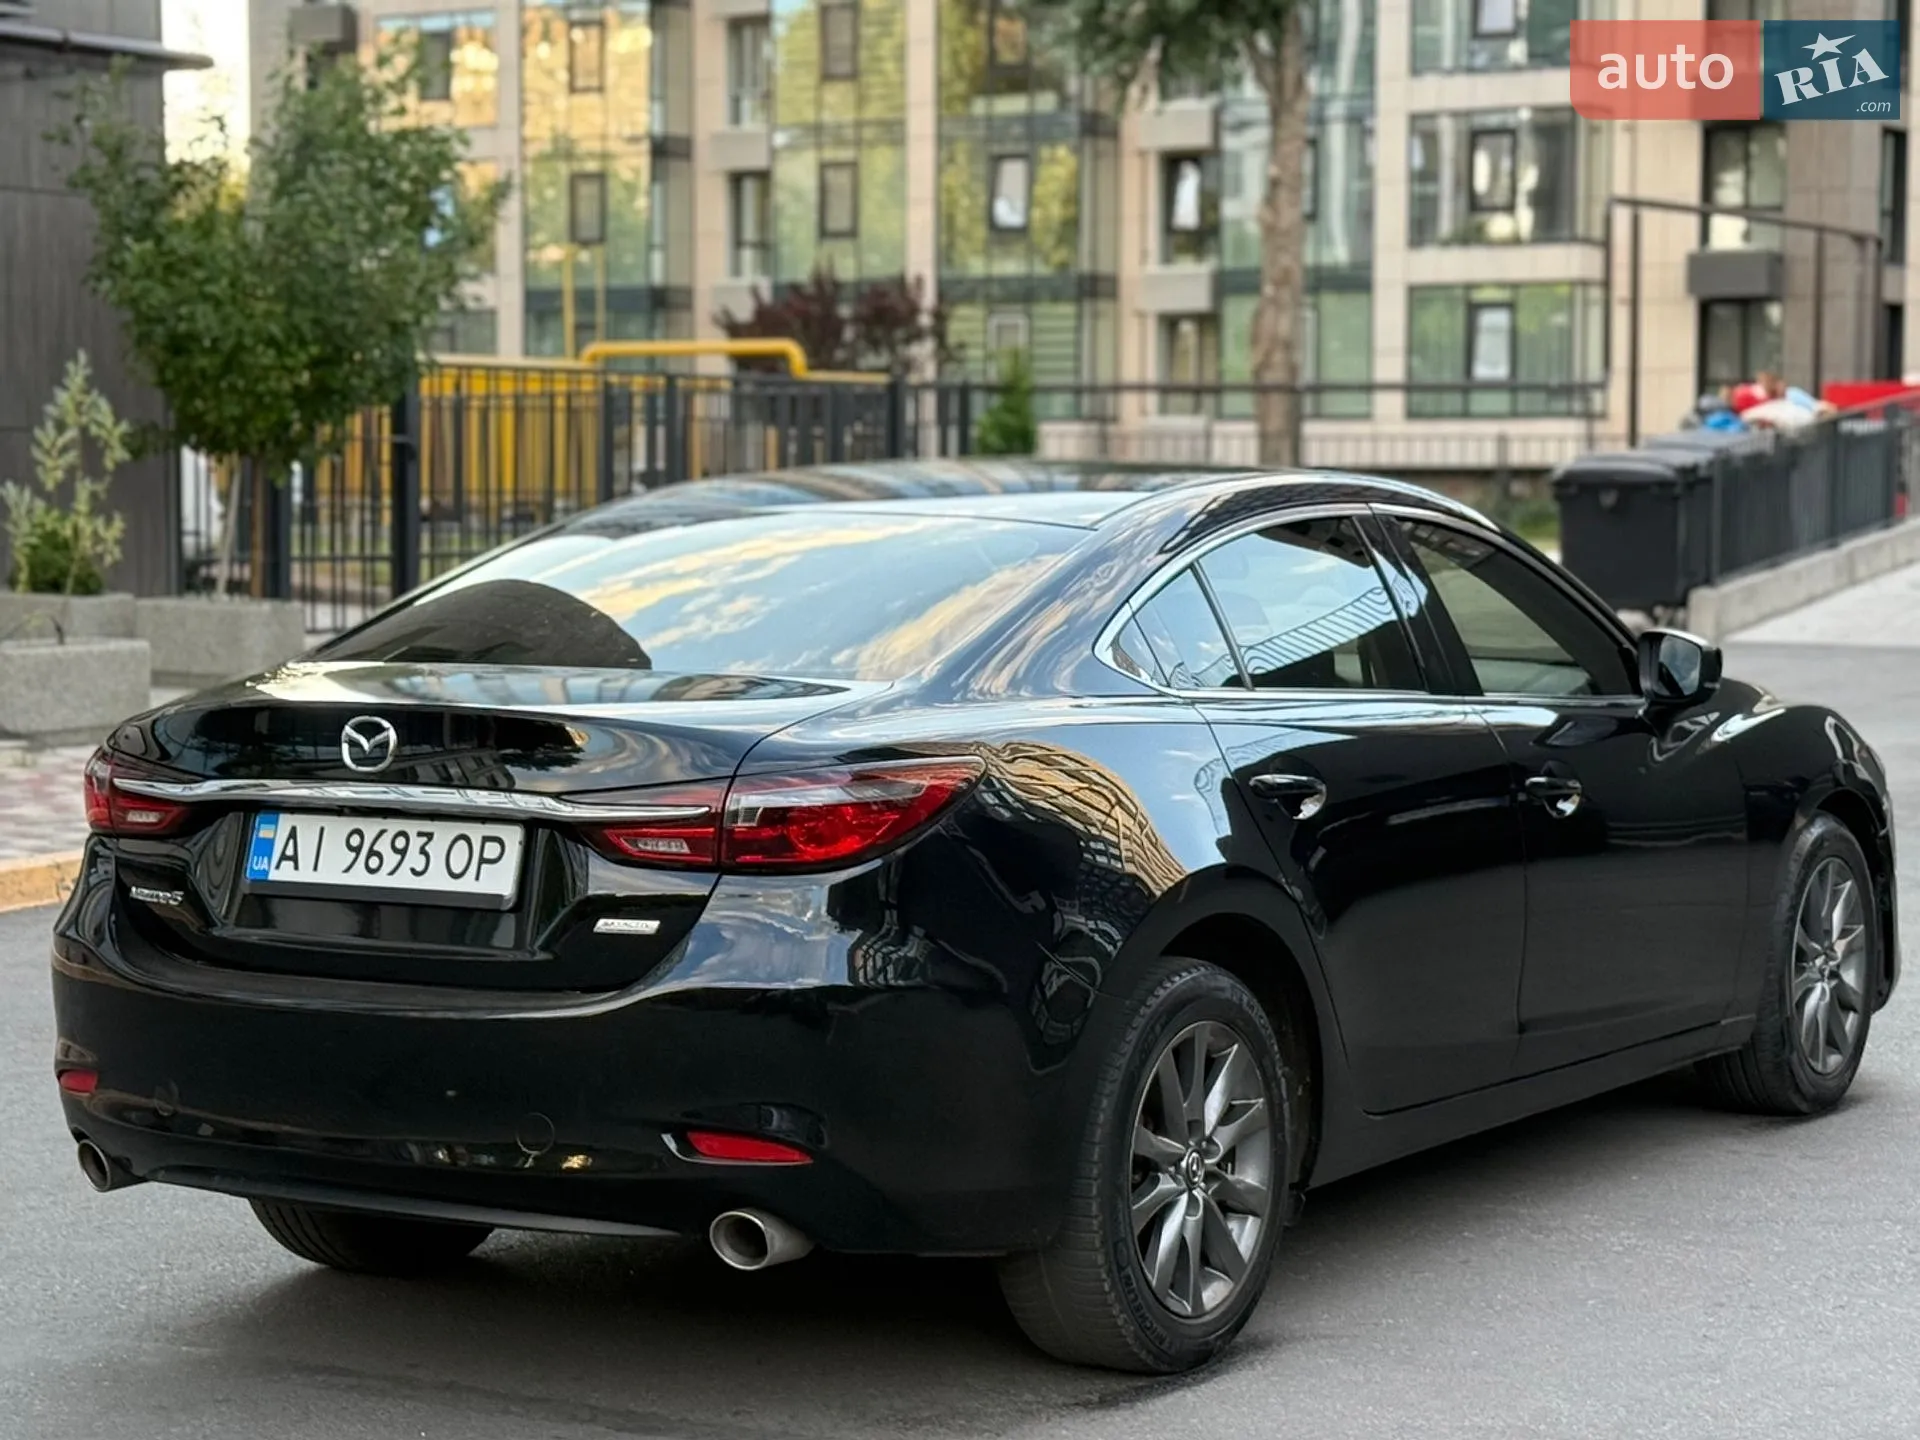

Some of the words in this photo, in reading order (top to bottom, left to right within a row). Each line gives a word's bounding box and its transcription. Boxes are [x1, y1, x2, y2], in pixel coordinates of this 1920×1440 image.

[252, 855, 269, 871] UA
[275, 825, 325, 872] AI
[342, 827, 435, 877] 9693
[445, 833, 506, 882] OP
